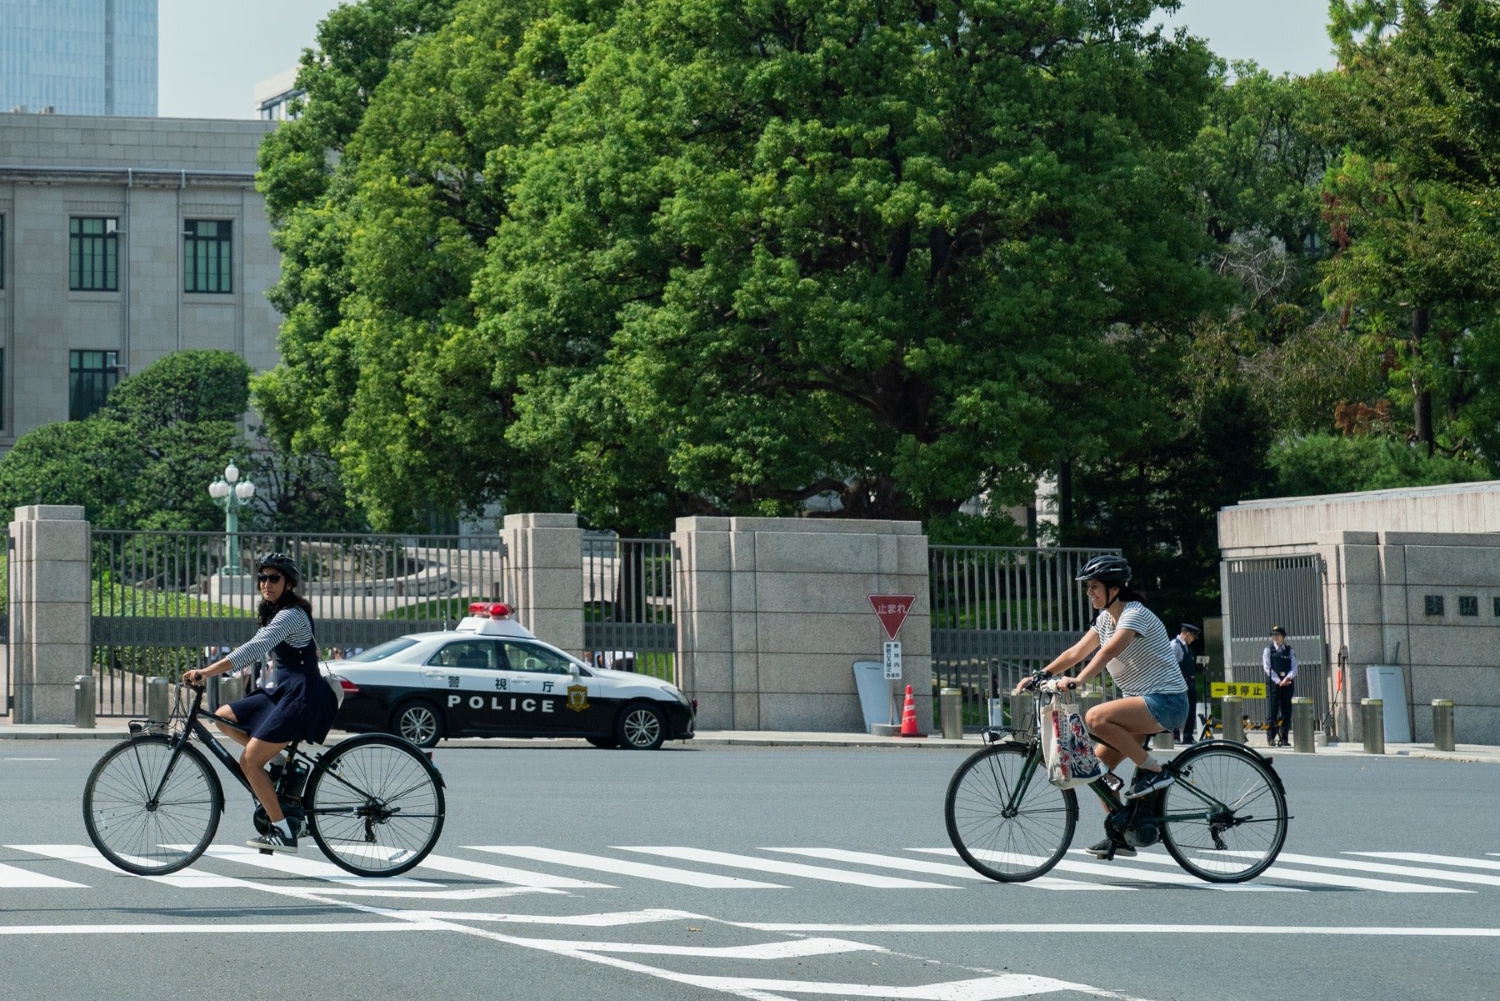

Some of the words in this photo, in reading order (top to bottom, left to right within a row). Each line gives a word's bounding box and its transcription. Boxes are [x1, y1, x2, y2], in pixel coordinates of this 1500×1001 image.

[877, 602, 907, 615] 止まれ
[448, 675, 554, 693] 警視庁
[1215, 685, 1262, 696] 一時停止
[447, 695, 554, 713] POLICE
